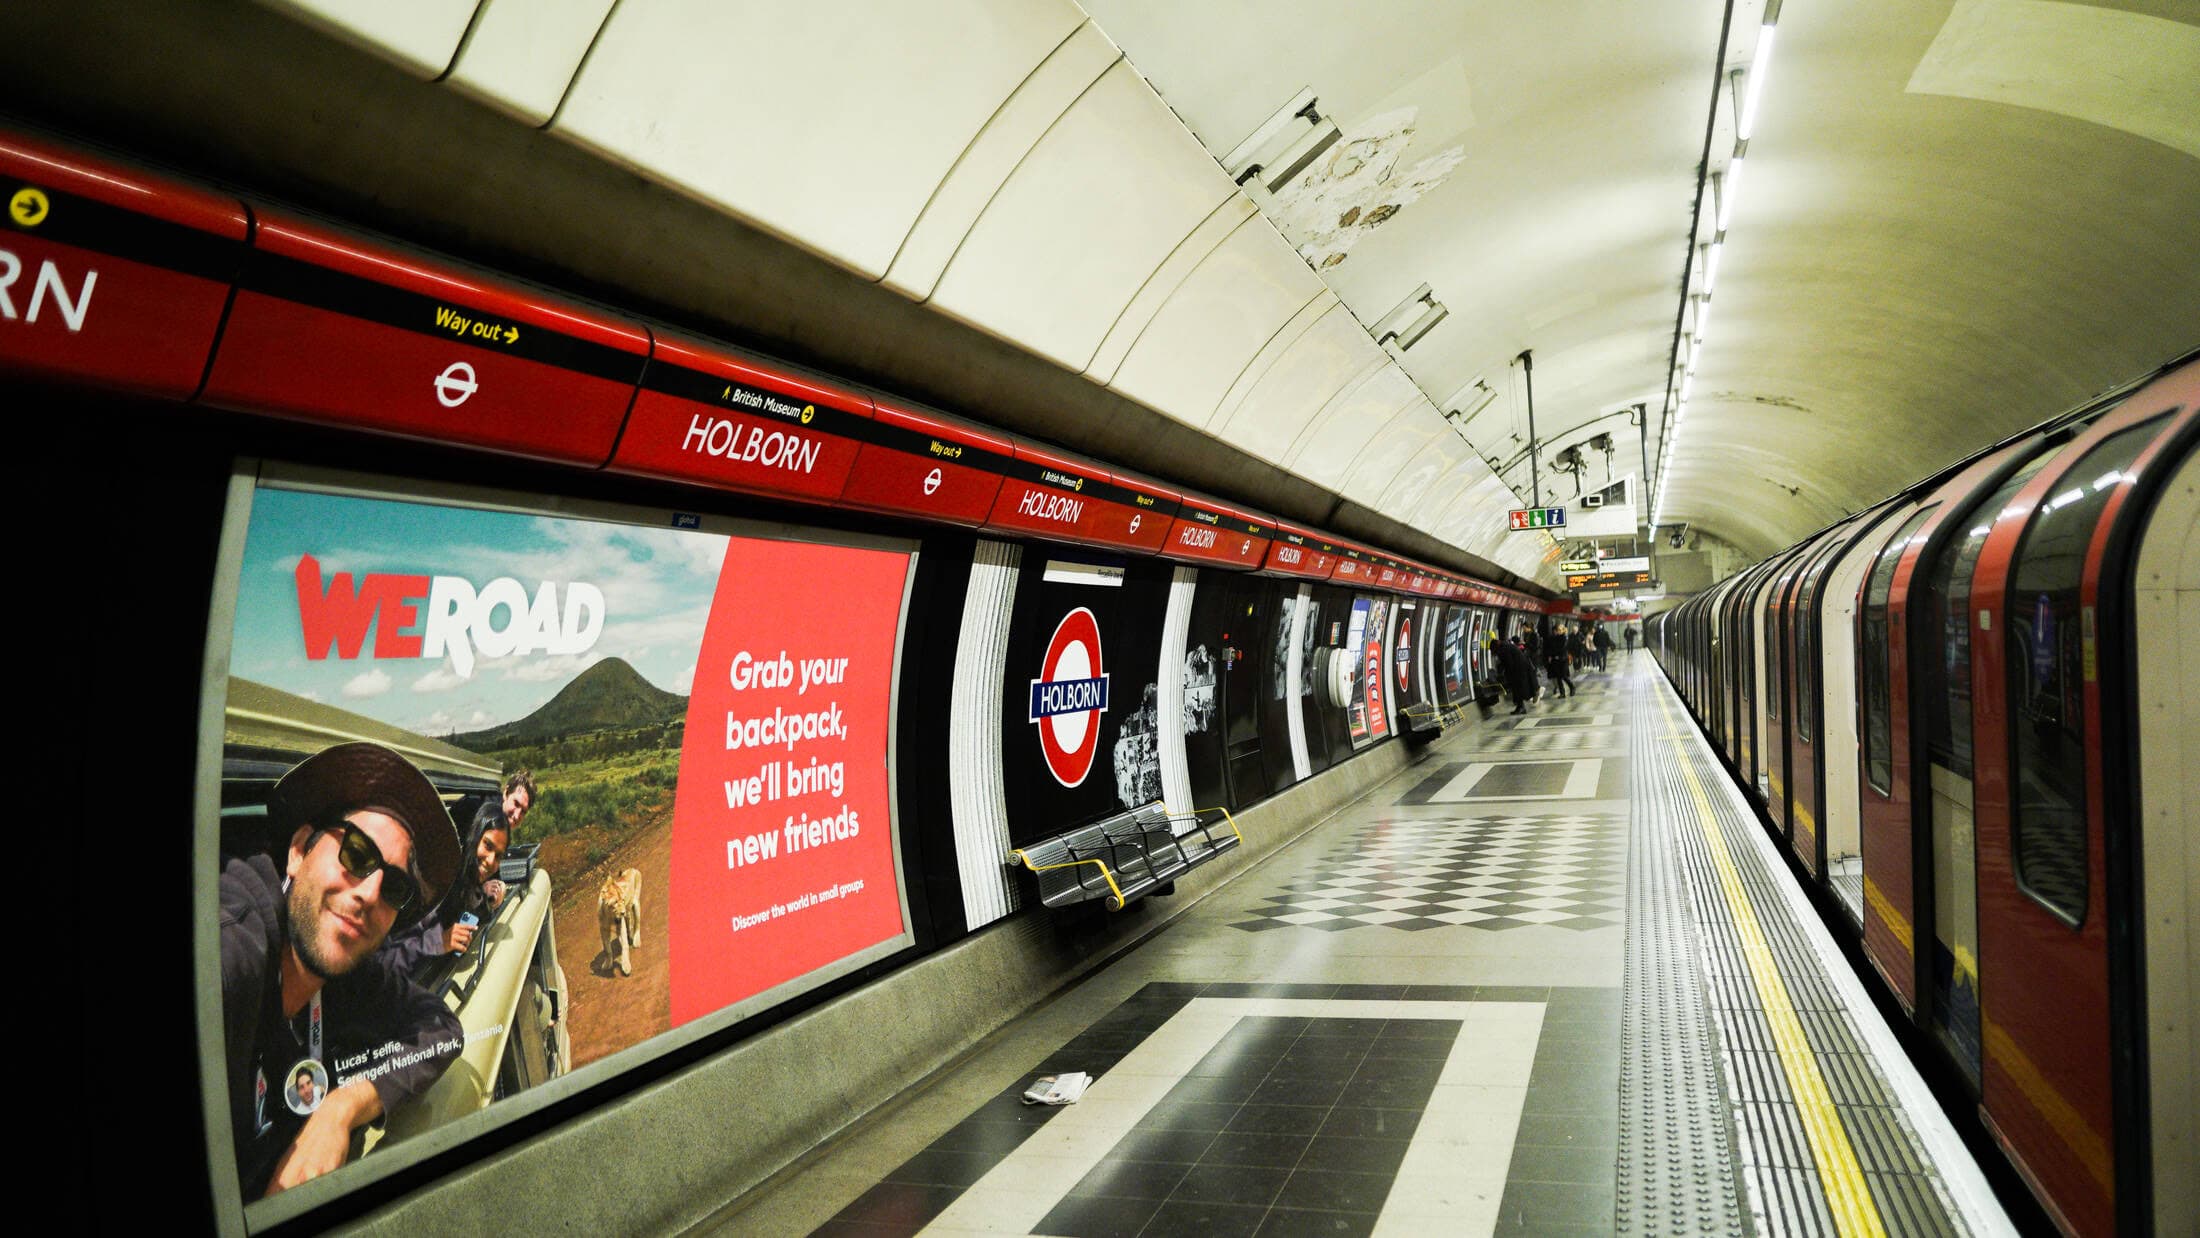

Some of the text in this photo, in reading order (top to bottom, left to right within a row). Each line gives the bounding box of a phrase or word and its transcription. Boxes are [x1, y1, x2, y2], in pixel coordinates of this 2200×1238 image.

[436, 306, 502, 341] Way out
[732, 388, 801, 418] British Museum
[681, 413, 822, 474] HOLBORN
[930, 440, 945, 456] Way
[1018, 489, 1084, 524] HOLBORN
[1179, 525, 1217, 549] HOLBORN
[294, 552, 606, 680] WEROAD
[729, 650, 849, 696] Grab your
[1040, 681, 1101, 714] HOLBORN
[725, 701, 848, 752] backpack,
[724, 756, 844, 809] we'll bring
[726, 804, 860, 870] new friends
[732, 879, 864, 932] Discover the world in small groups
[334, 1040, 405, 1073] Lucas' selfie,
[336, 1061, 391, 1089] Serengeti
[391, 1044, 435, 1073] National
[435, 1037, 462, 1055] Park,
